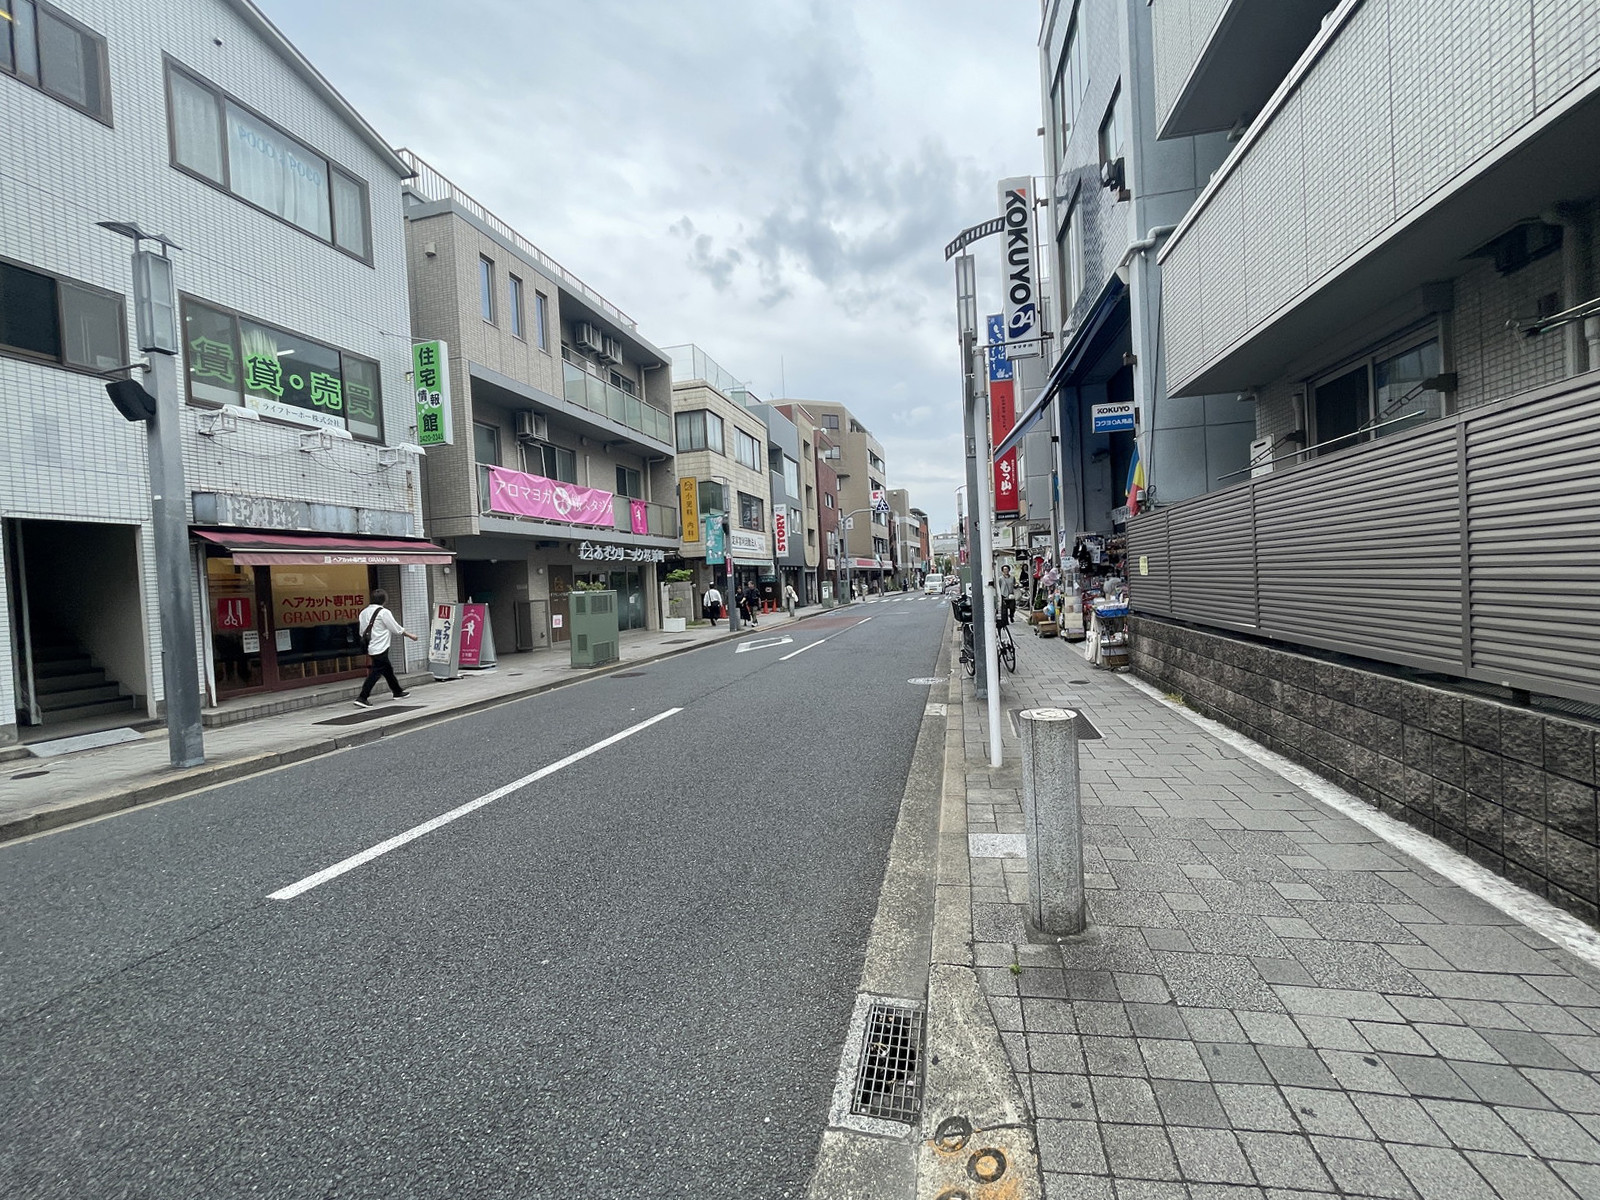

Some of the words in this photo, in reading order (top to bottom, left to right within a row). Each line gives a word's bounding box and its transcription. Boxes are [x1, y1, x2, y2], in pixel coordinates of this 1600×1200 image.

[1006, 189, 1032, 304] KOKUYO
[1010, 309, 1034, 328] OA
[418, 346, 440, 433] 住宅情報館
[1096, 406, 1130, 414] KOKUYO
[494, 480, 551, 504] アロマヨガ
[776, 513, 786, 552] STORY
[282, 595, 364, 608] ヘアカット専門店
[283, 610, 330, 624] GRAND
